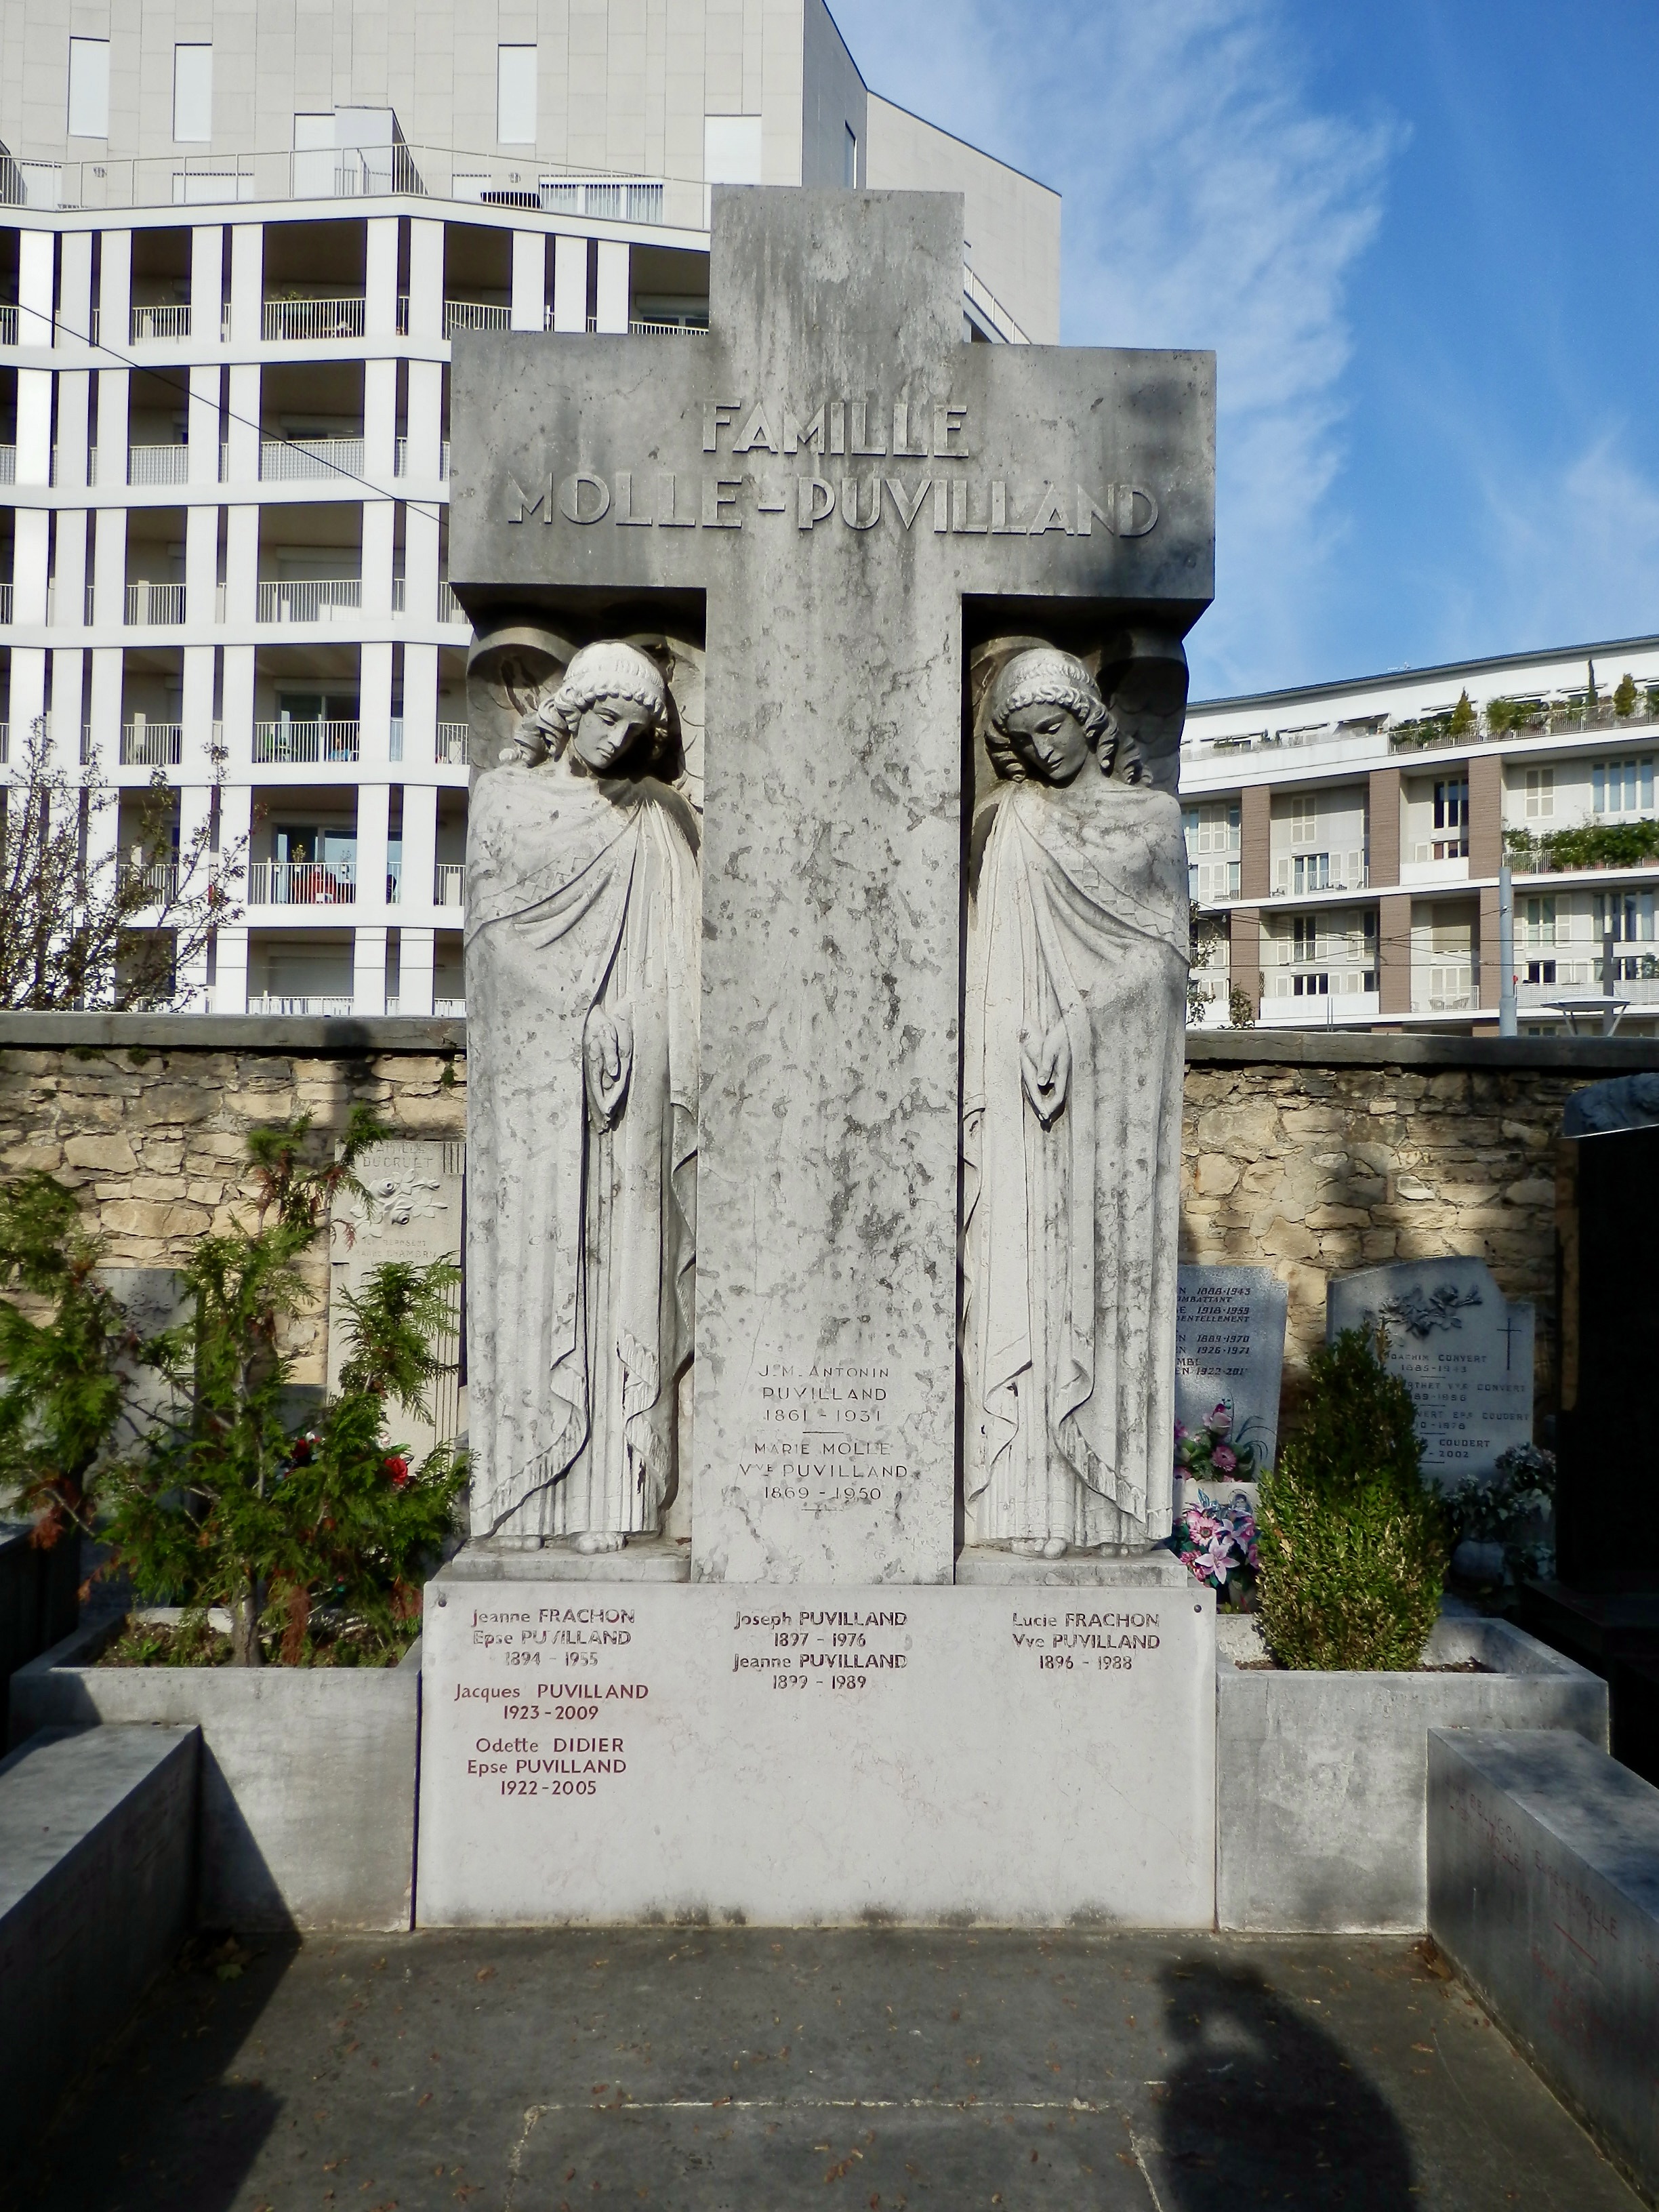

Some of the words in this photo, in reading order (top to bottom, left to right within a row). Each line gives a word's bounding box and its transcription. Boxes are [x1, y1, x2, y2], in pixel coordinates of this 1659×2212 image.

[702, 399, 968, 459] FAMILLE
[1438, 1354, 1488, 1363] CONVERT
[809, 1365, 888, 1378] ANTONIN
[762, 1387, 886, 1401] PUVILLAND
[1477, 1384, 1525, 1392] CONVERT
[766, 1409, 807, 1422] 1861
[837, 1409, 880, 1422] 1931
[1481, 1412, 1530, 1420] COUDERT
[754, 1442, 810, 1455] MARIE
[823, 1442, 891, 1456] MOLLE
[1439, 1438, 1490, 1448] COUDERT
[783, 1464, 907, 1478] PUVILLAND
[765, 1486, 809, 1500] 1869
[836, 1486, 882, 1500] 1950
[539, 1608, 635, 1624] FRACHON
[734, 1611, 792, 1630] Joseph
[799, 1612, 908, 1626] PUVILLAND
[1012, 1612, 1057, 1627] Lucie
[1065, 1613, 1160, 1628] FRACHON
[473, 1630, 514, 1648] Epse
[521, 1629, 632, 1645] PUVILLAND
[775, 1633, 809, 1647] 1897
[832, 1633, 867, 1647] 1976
[1012, 1633, 1045, 1648] Vve
[1052, 1634, 1161, 1649] PUVILLAND
[506, 1651, 541, 1666] 1894
[565, 1651, 599, 1667] 1955
[733, 1653, 792, 1673] Jeanne
[799, 1654, 908, 1669] PUVILLAND
[1039, 1655, 1073, 1670] 1896
[1098, 1655, 1133, 1671] 1988
[773, 1674, 808, 1689] 1899
[832, 1674, 867, 1689] 1989
[454, 1683, 520, 1703] Jacques
[537, 1684, 649, 1700] PUVILLAND
[475, 1738, 539, 1753] Odette
[553, 1738, 625, 1753] DIDIER
[467, 1759, 508, 1777] Epse
[516, 1759, 627, 1774] PUVILLAND
